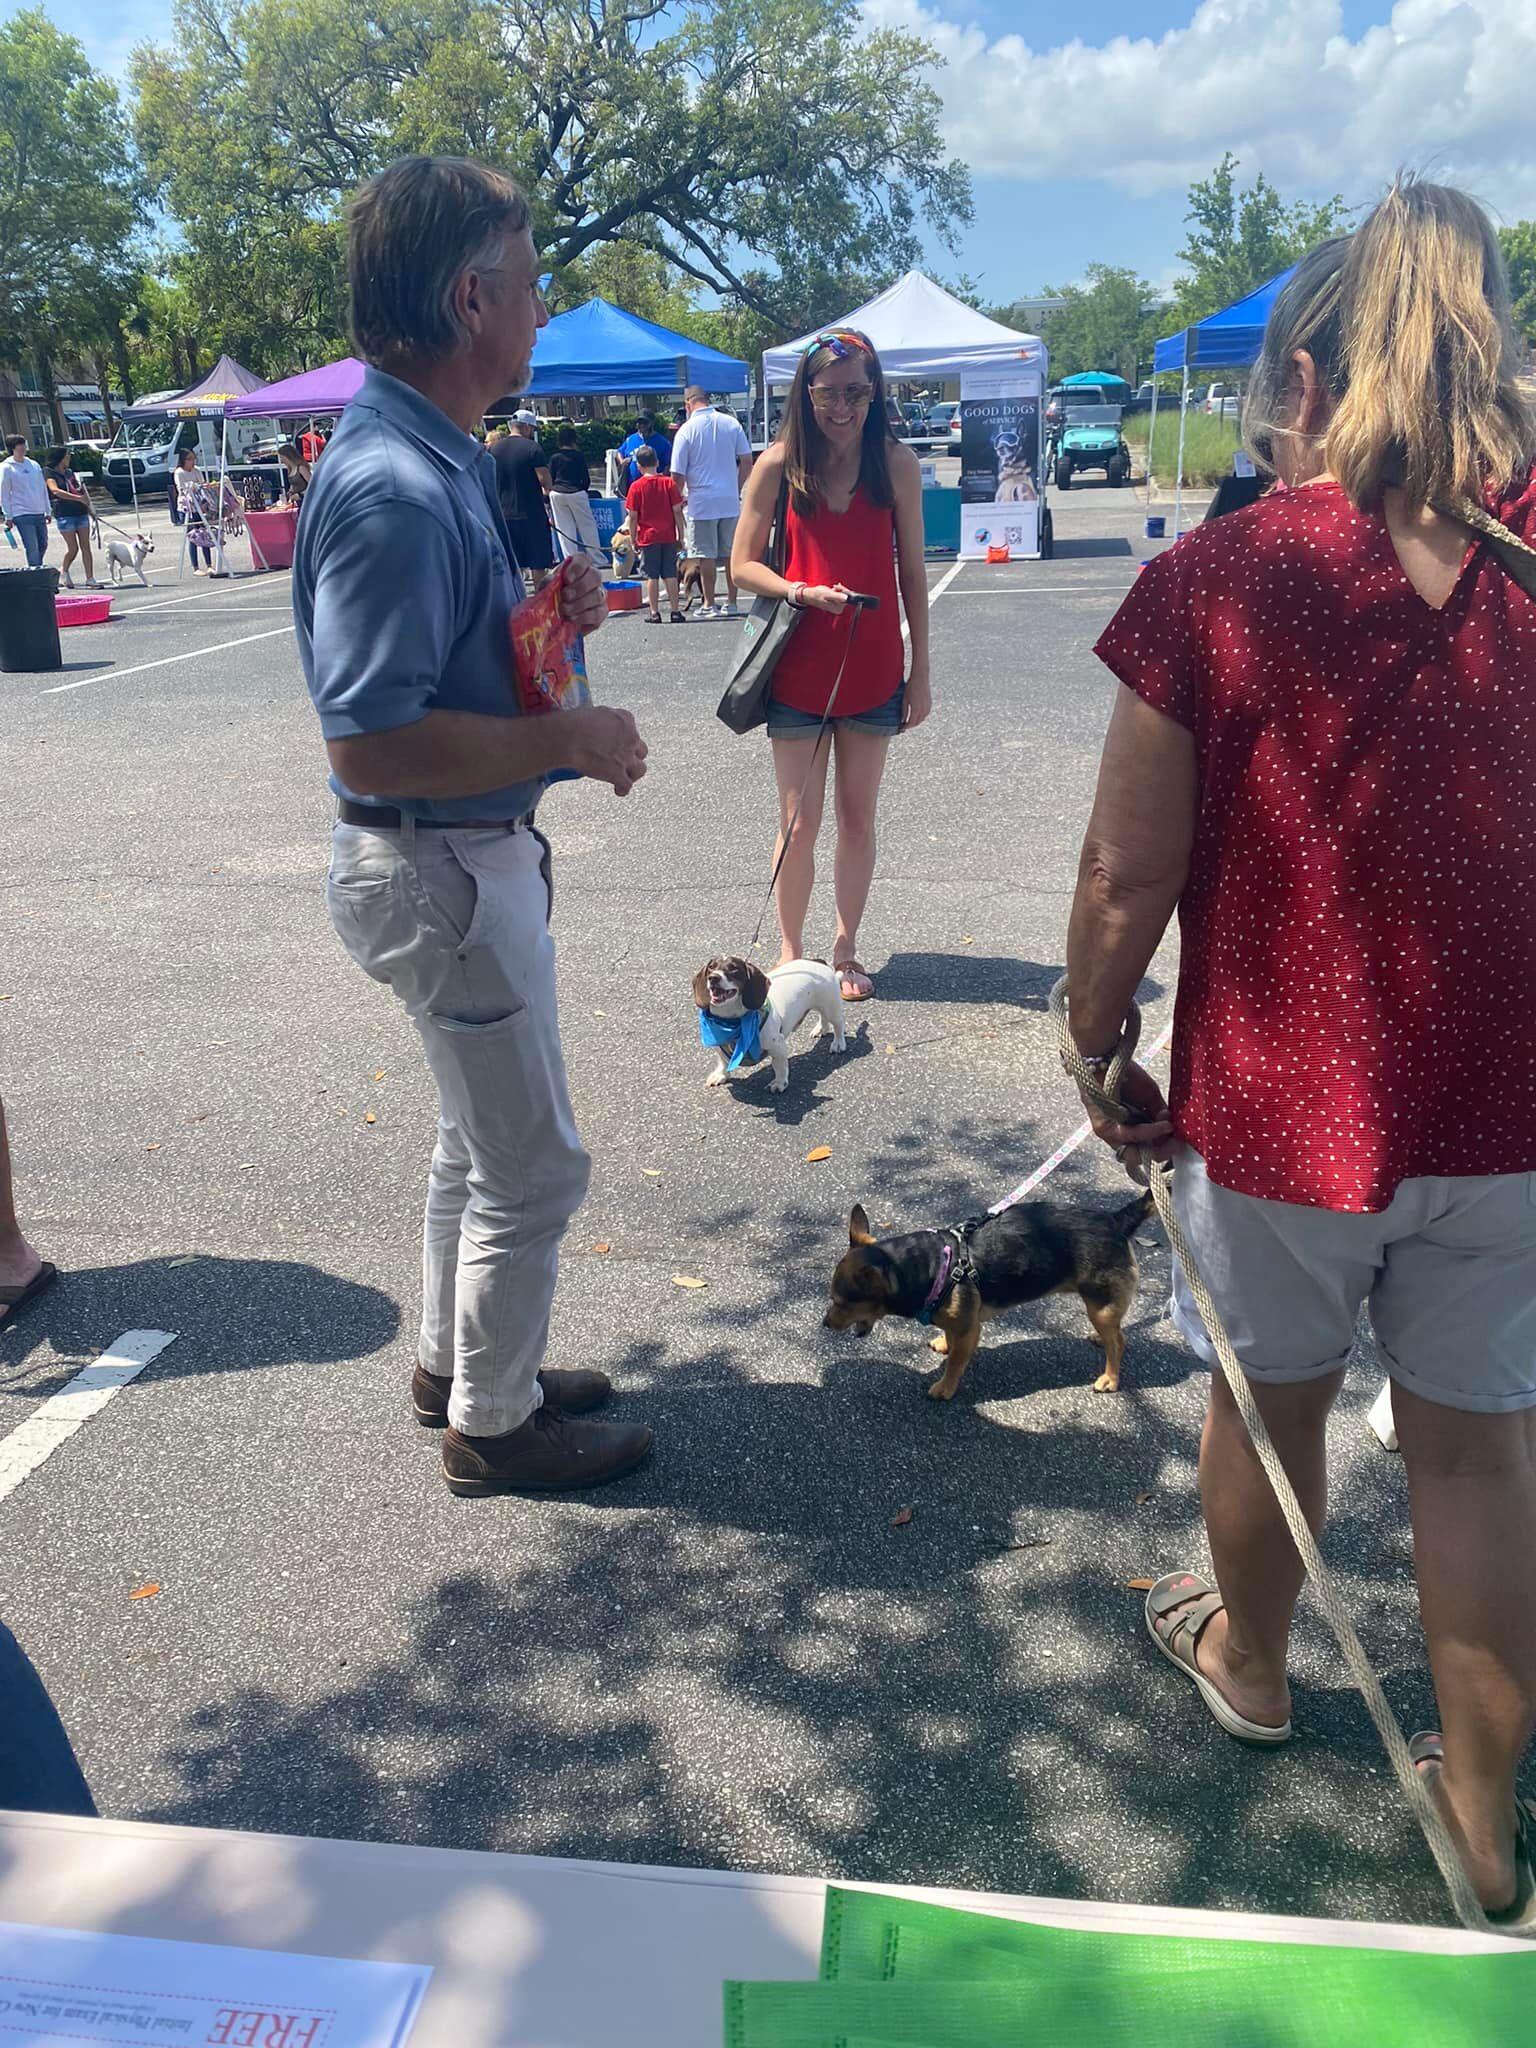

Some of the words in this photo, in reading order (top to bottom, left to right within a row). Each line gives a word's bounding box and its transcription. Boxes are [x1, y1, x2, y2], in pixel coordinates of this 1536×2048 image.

[964, 406, 999, 418] GOOD
[1003, 404, 1035, 416] DOGS
[989, 416, 1017, 425] SERVICE
[14, 2002, 38, 2016] New
[42, 2006, 61, 2020] for
[63, 2007, 99, 2024] Exam
[100, 2012, 152, 2030] Physical
[151, 2017, 193, 2033] Initial
[206, 2008, 325, 2048] FREE
